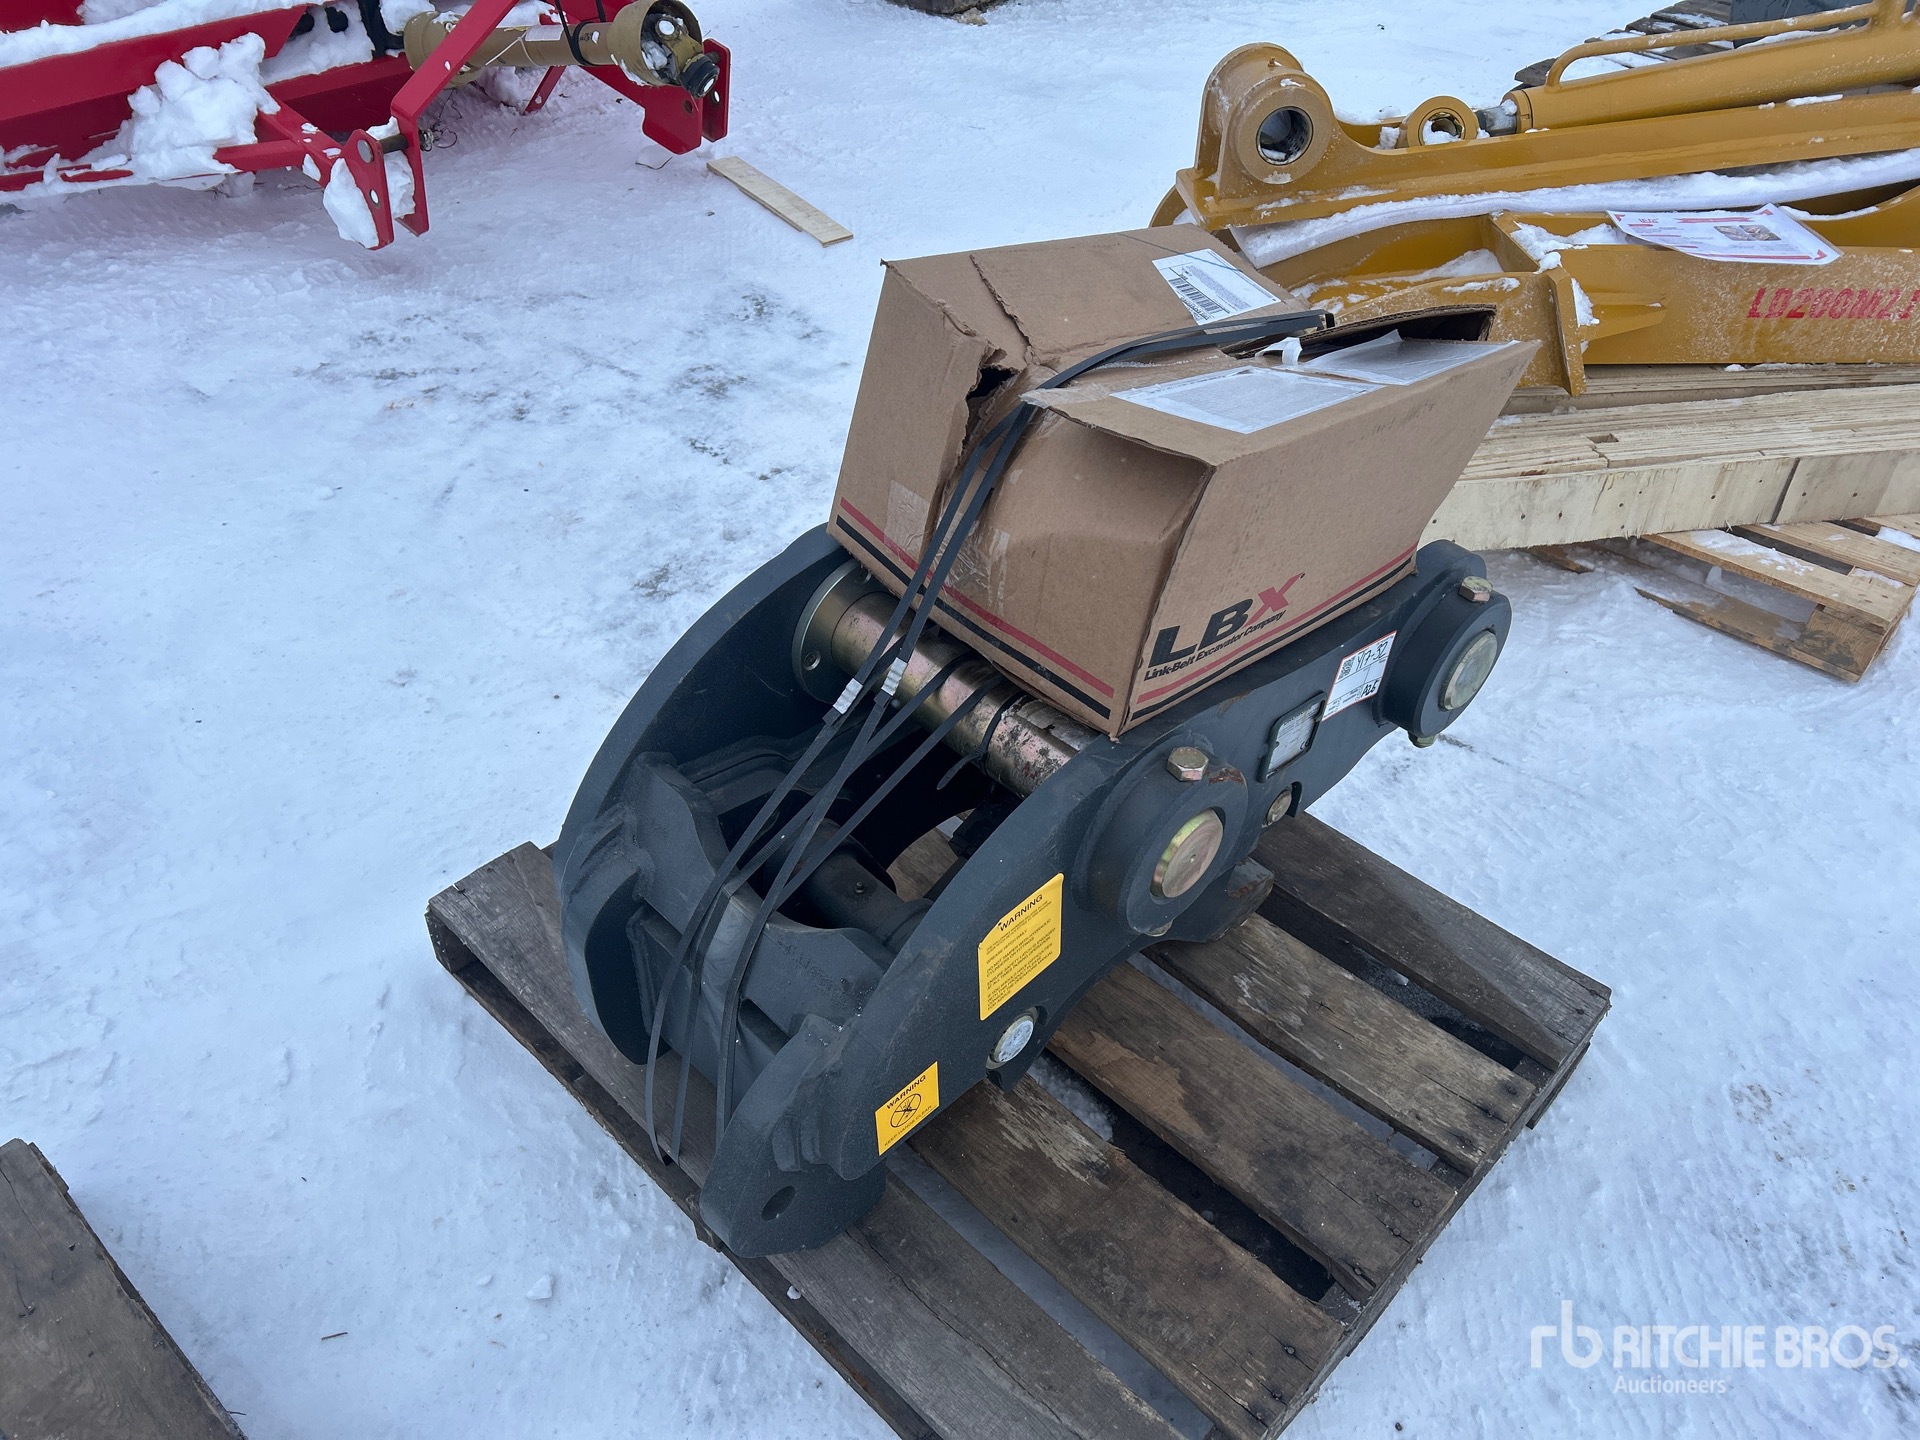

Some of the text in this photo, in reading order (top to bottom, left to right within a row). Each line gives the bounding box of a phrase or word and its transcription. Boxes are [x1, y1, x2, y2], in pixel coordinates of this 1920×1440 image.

[1144, 609, 1287, 681] Link-Belt Excavator Company
[1148, 573, 1303, 668] LBX
[1000, 894, 1043, 932] WARNING
[886, 1074, 926, 1109] WARNING
